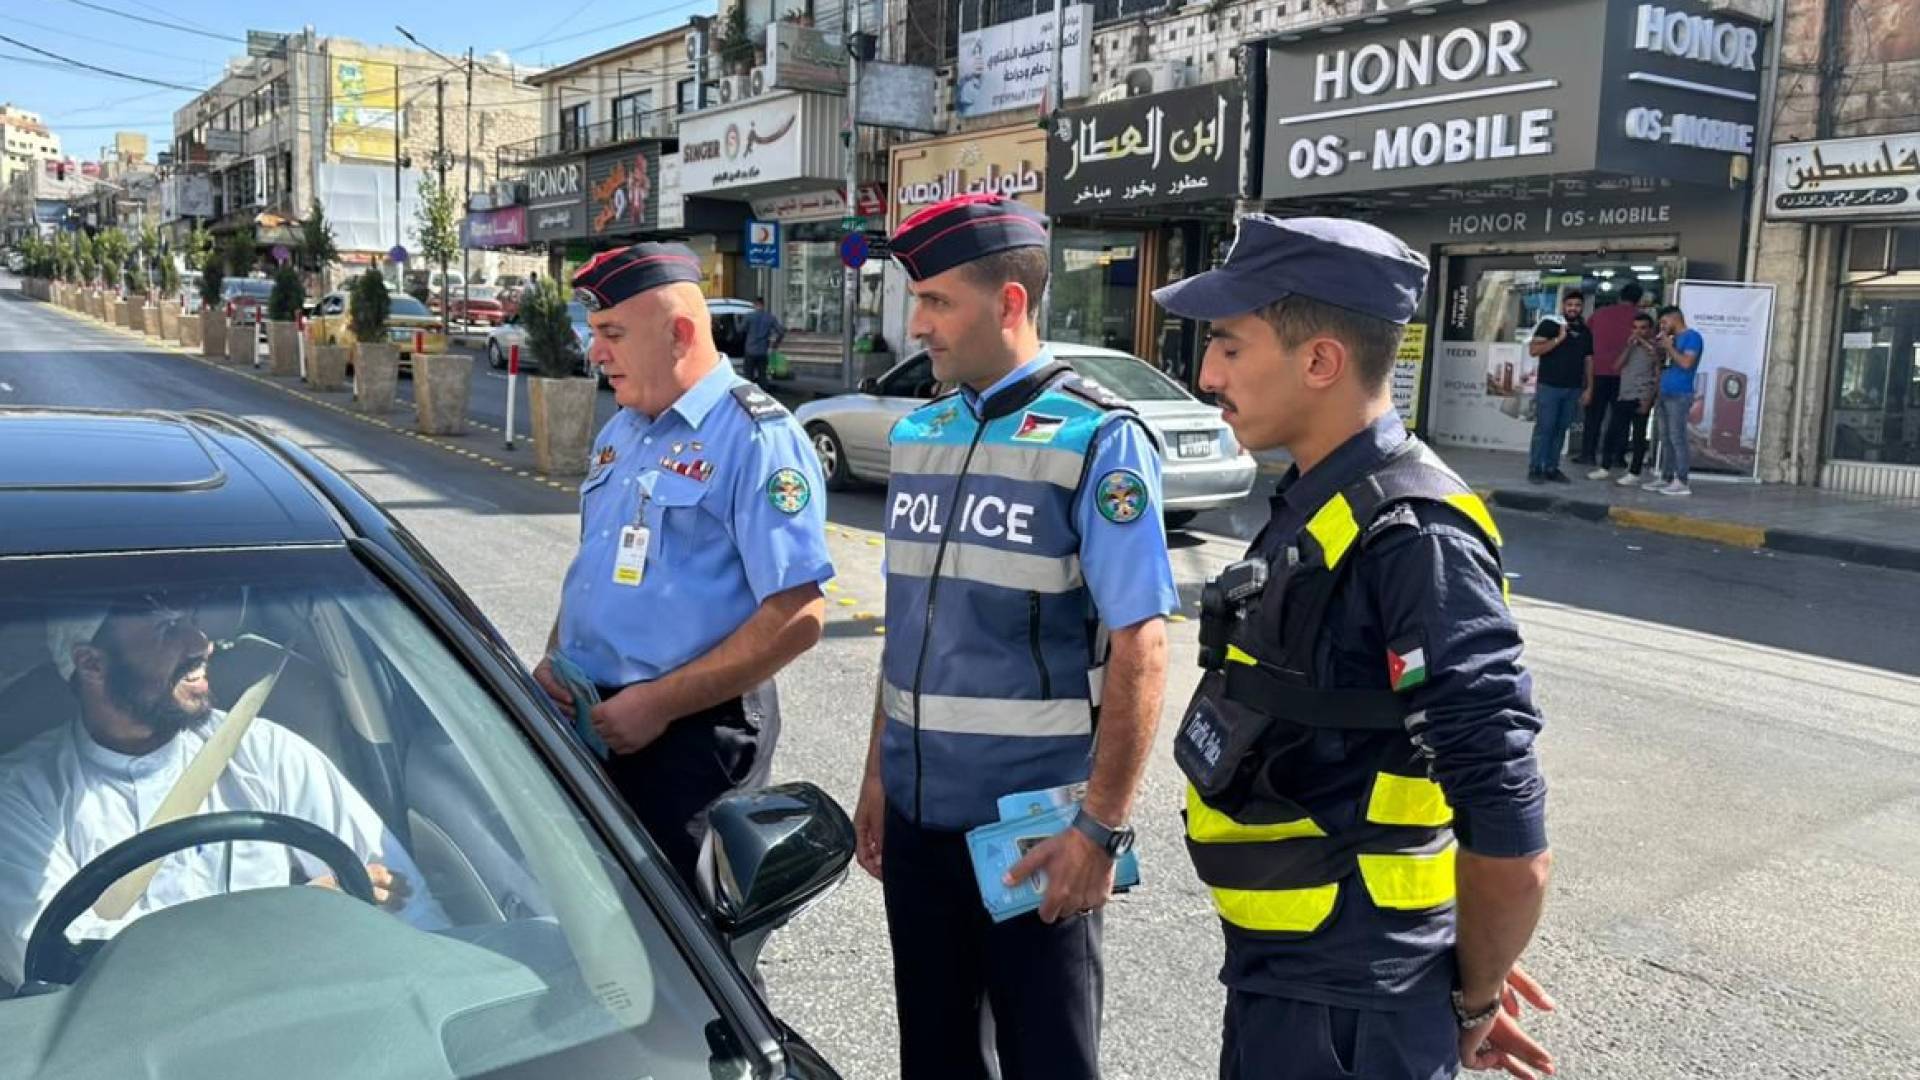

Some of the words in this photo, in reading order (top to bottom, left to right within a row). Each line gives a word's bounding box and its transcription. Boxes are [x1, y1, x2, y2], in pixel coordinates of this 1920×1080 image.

[1635, 4, 1757, 72] HONOR
[1314, 19, 1528, 103] HONOR
[1063, 105, 1165, 181] العطار
[1169, 94, 1228, 163] ابن
[1288, 134, 1345, 180] OS
[1372, 108, 1554, 171] MOBILE
[683, 139, 721, 164] SINGER
[529, 164, 578, 199] HONOR
[1073, 184, 1112, 205] مباخر
[1121, 178, 1157, 199] بخور
[1167, 174, 1209, 195] عطور
[1449, 211, 1527, 234] HONOR
[1561, 211, 1585, 228] OS
[1599, 205, 1672, 225] MOBILE
[891, 491, 1035, 545] POLICE
